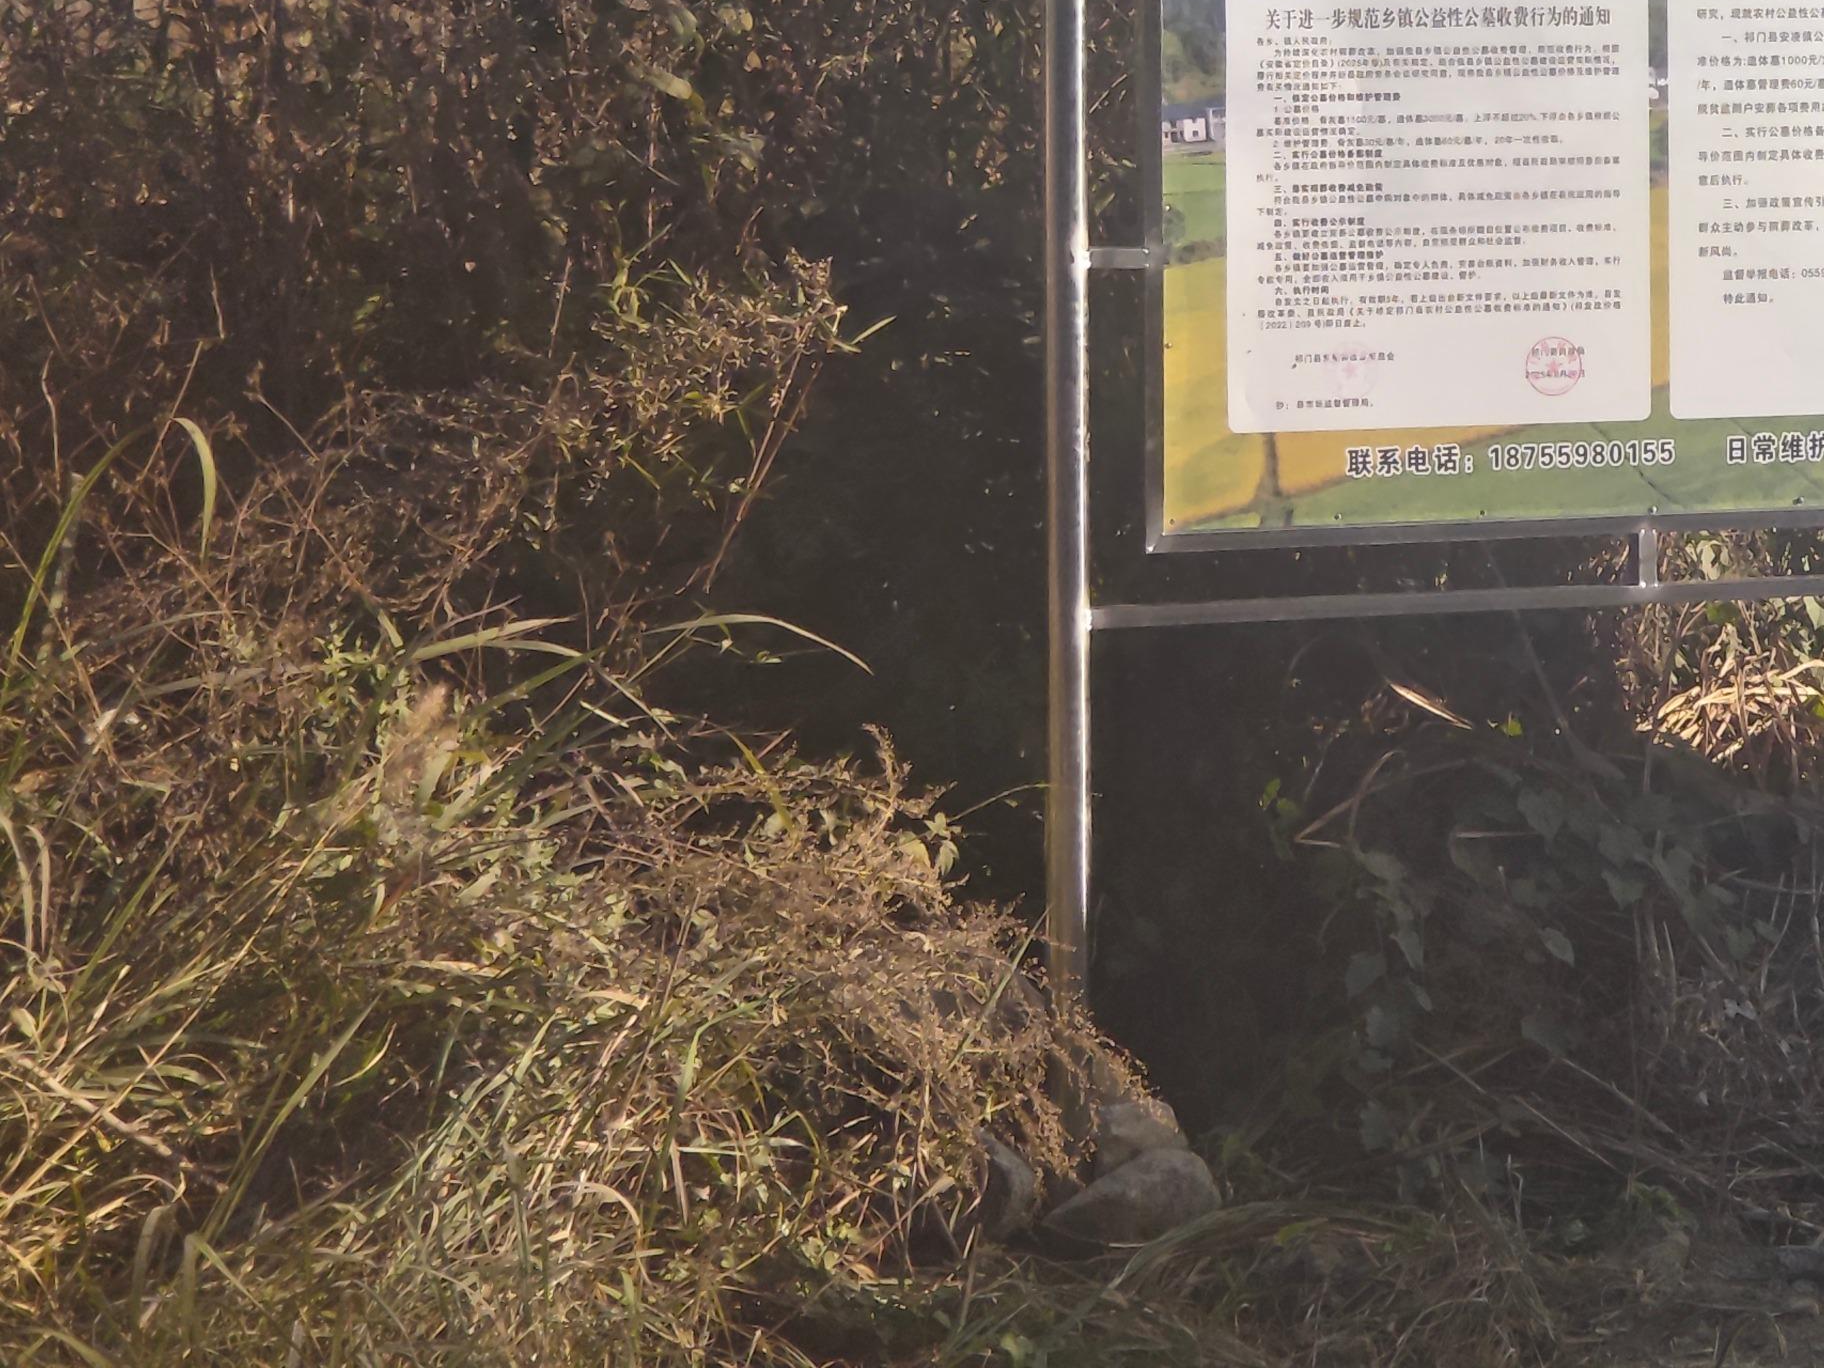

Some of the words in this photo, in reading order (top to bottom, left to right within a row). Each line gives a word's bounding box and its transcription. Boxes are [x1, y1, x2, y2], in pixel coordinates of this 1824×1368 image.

[1265, 5, 1611, 30] 关于进一步规范乡镇公益性公墓收费行为的通知
